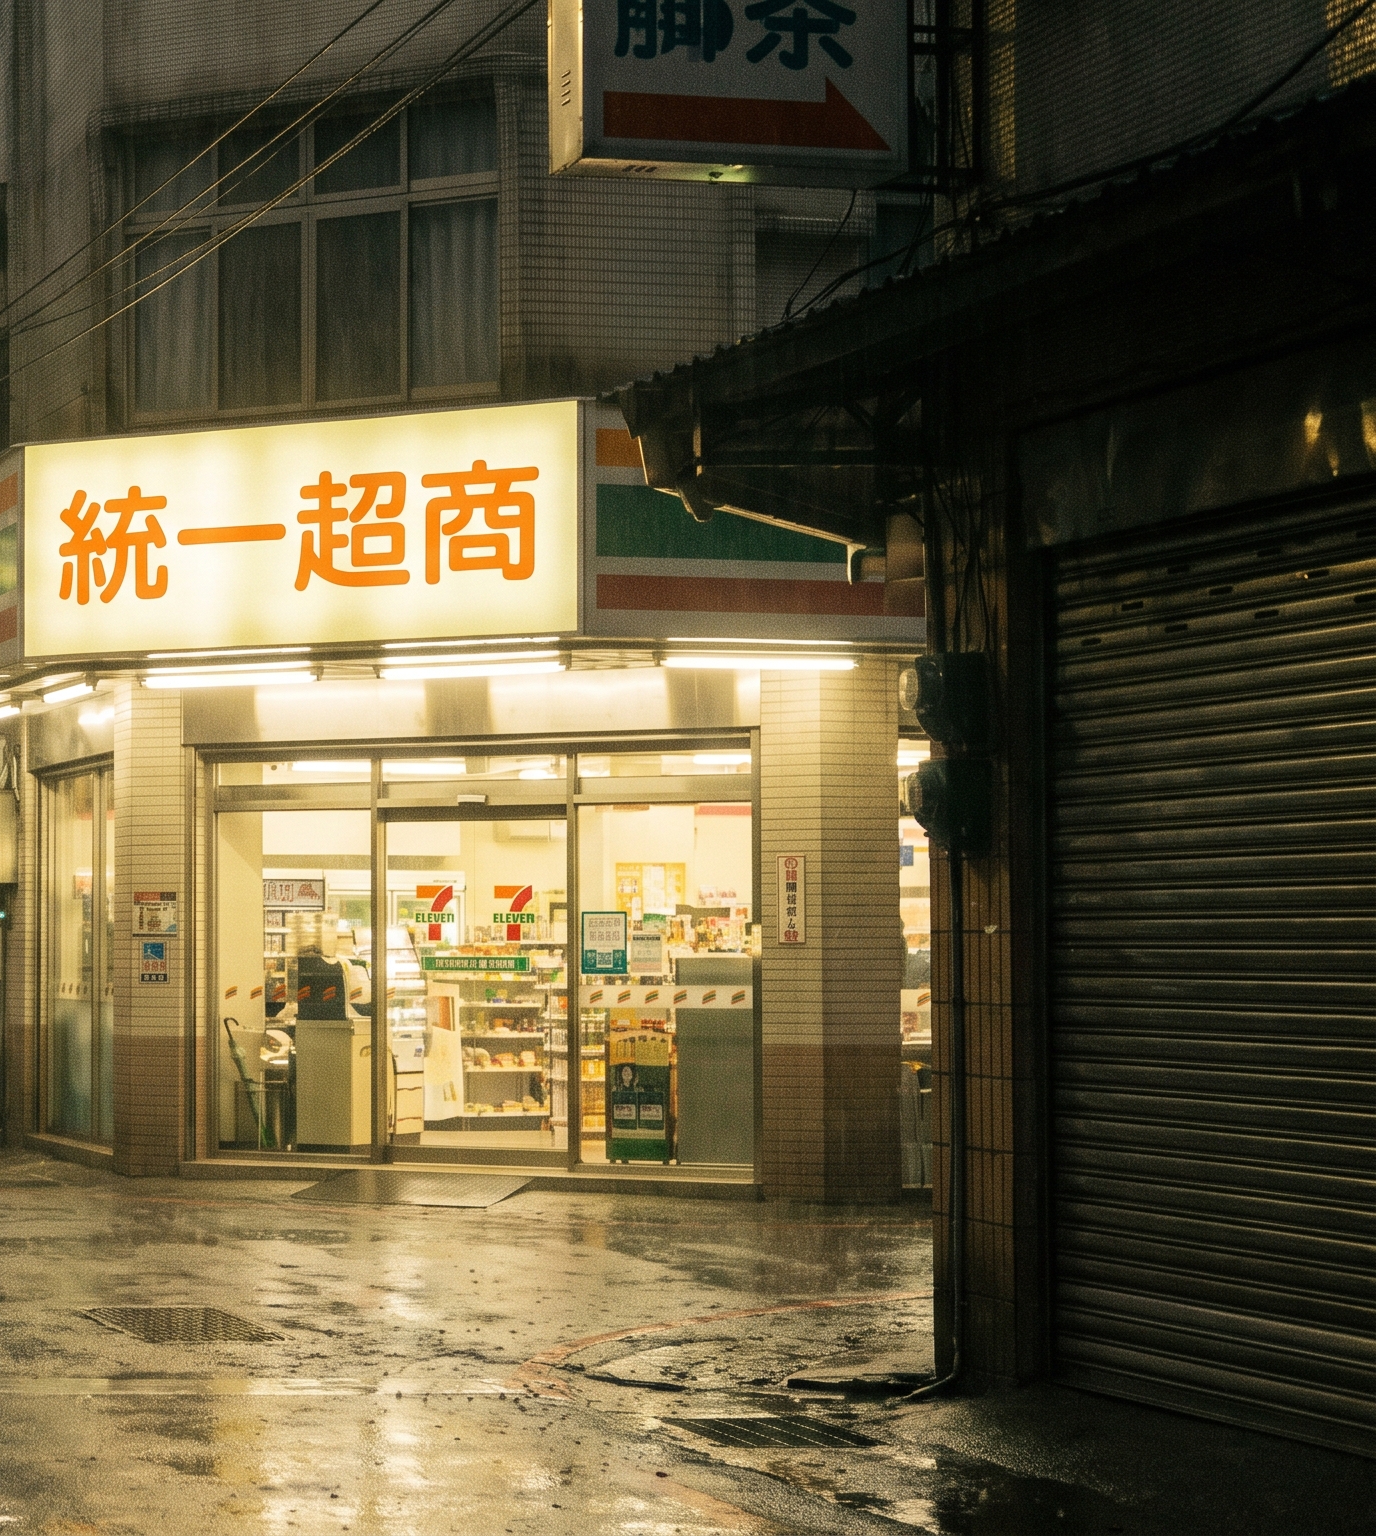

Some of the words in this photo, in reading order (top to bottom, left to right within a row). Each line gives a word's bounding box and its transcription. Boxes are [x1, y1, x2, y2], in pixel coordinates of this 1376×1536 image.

[58, 459, 540, 606] 統一超商
[415, 885, 453, 941] 7
[493, 885, 532, 941] 7
